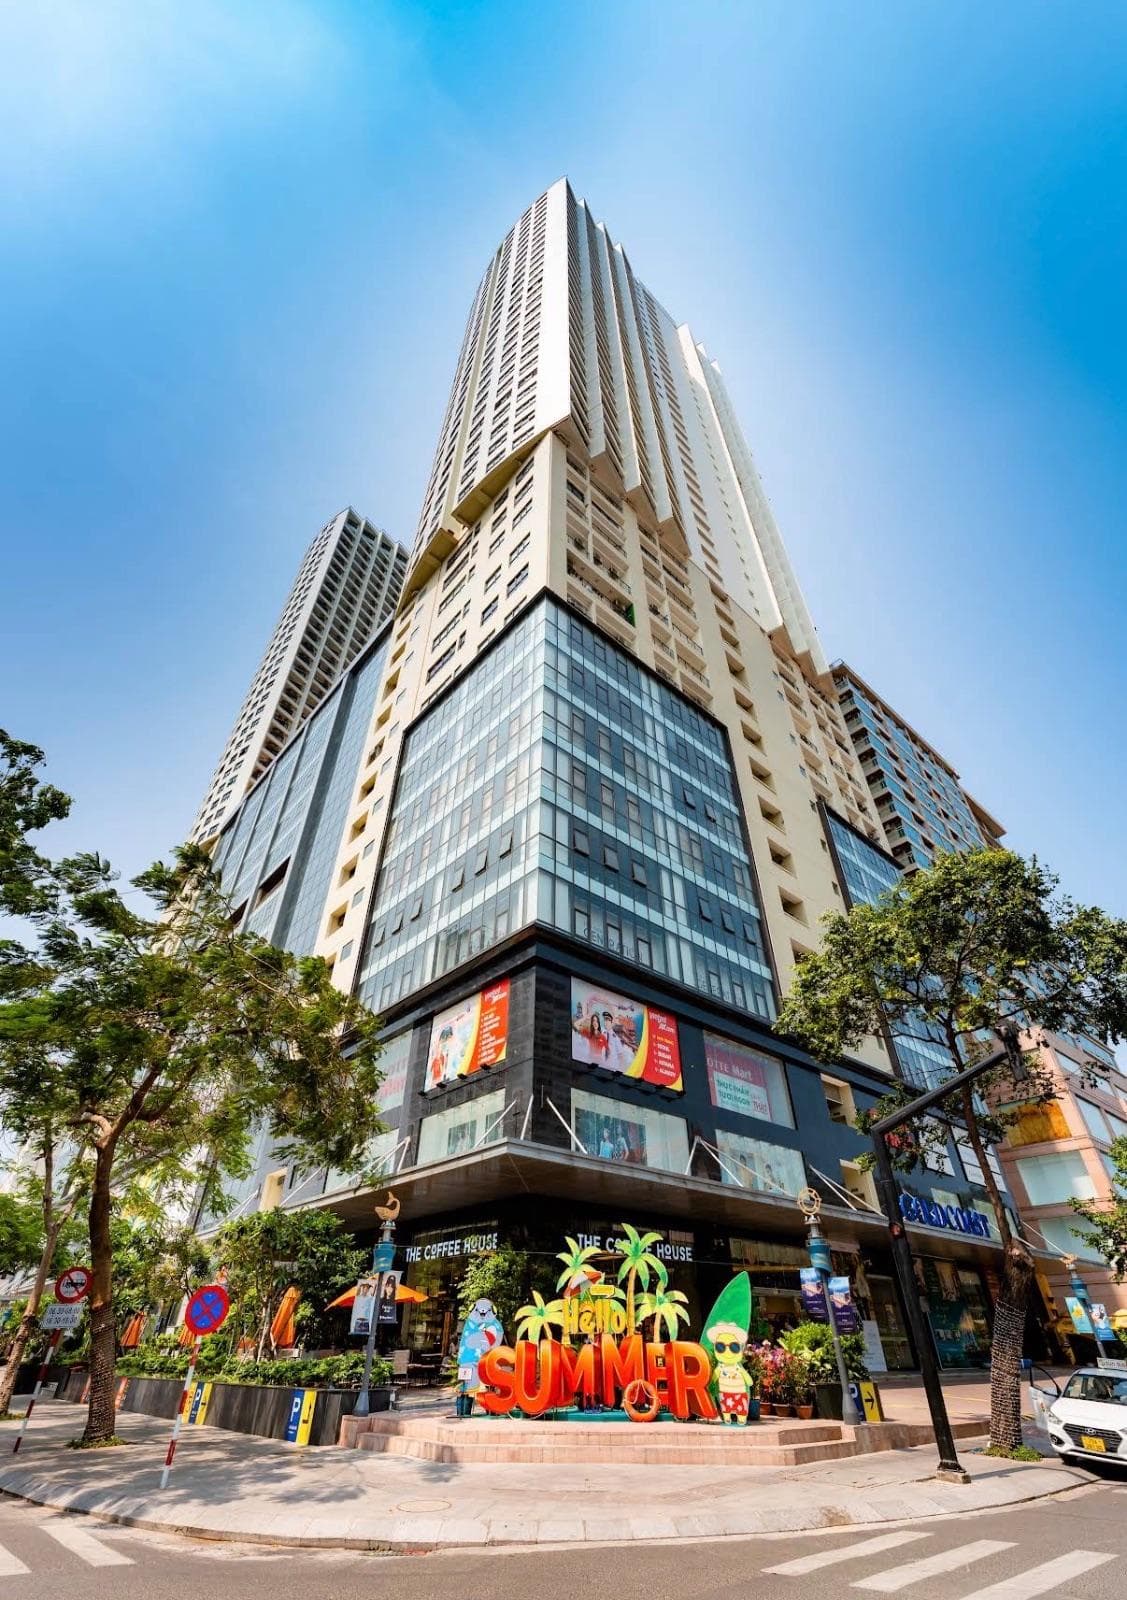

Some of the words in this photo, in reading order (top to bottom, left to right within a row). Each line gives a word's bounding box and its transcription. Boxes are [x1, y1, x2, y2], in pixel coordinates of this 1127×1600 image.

[405, 1247, 421, 1262] THE
[424, 1239, 461, 1260] COFFEE
[463, 1232, 498, 1254] HOUSE
[577, 1233, 601, 1249] THE
[656, 1243, 693, 1262] HOUSE
[562, 1298, 627, 1334] Hello
[478, 1334, 720, 1419] SUMMER
[290, 1397, 301, 1422] P
